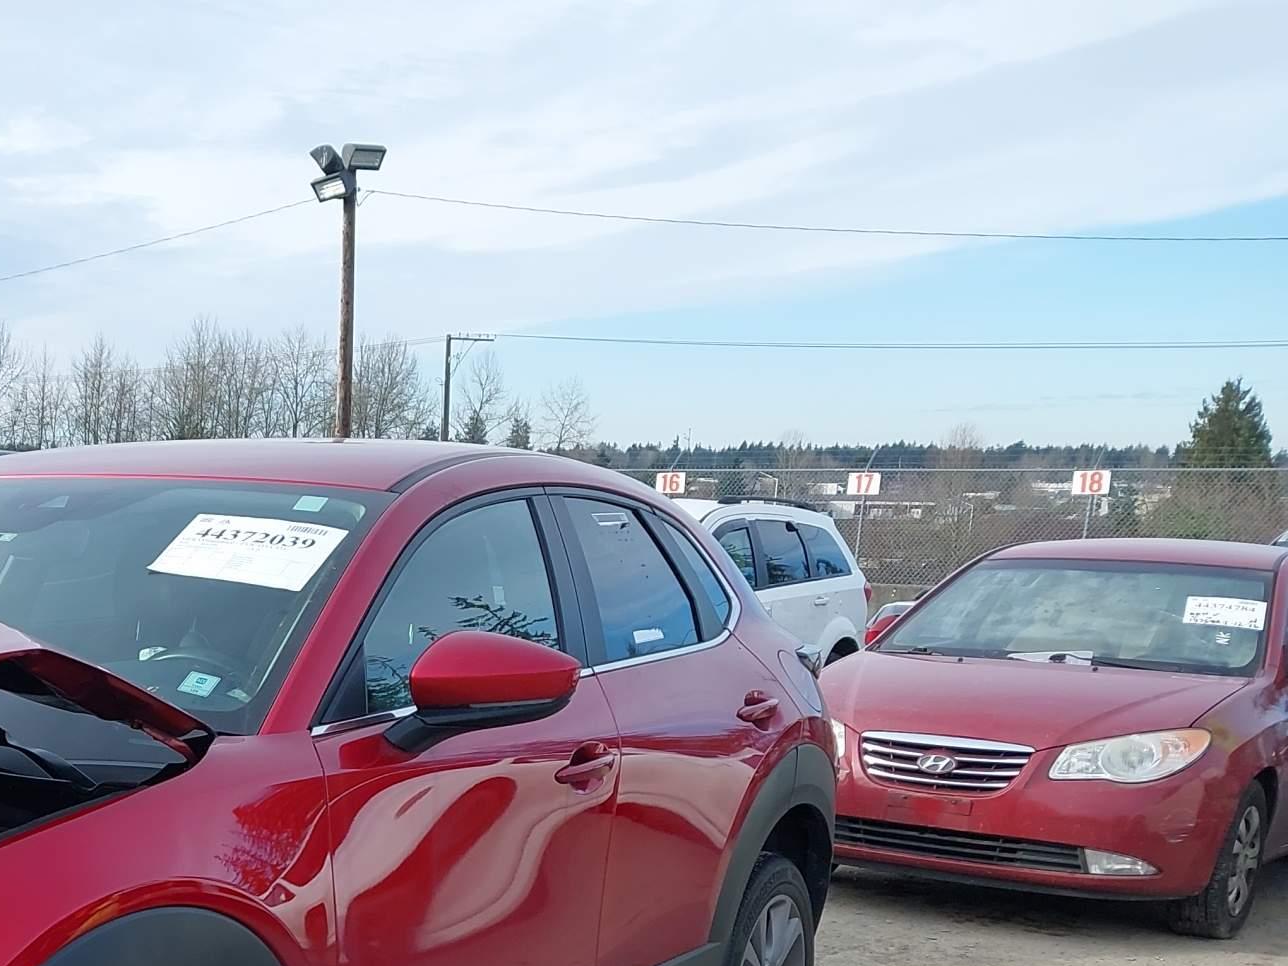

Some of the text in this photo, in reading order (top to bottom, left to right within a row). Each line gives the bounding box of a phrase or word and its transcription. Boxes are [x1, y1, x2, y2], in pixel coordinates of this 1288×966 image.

[661, 474, 680, 492] 16
[856, 474, 874, 493] 17
[1080, 472, 1103, 493] 18
[196, 527, 316, 549] 44372039
